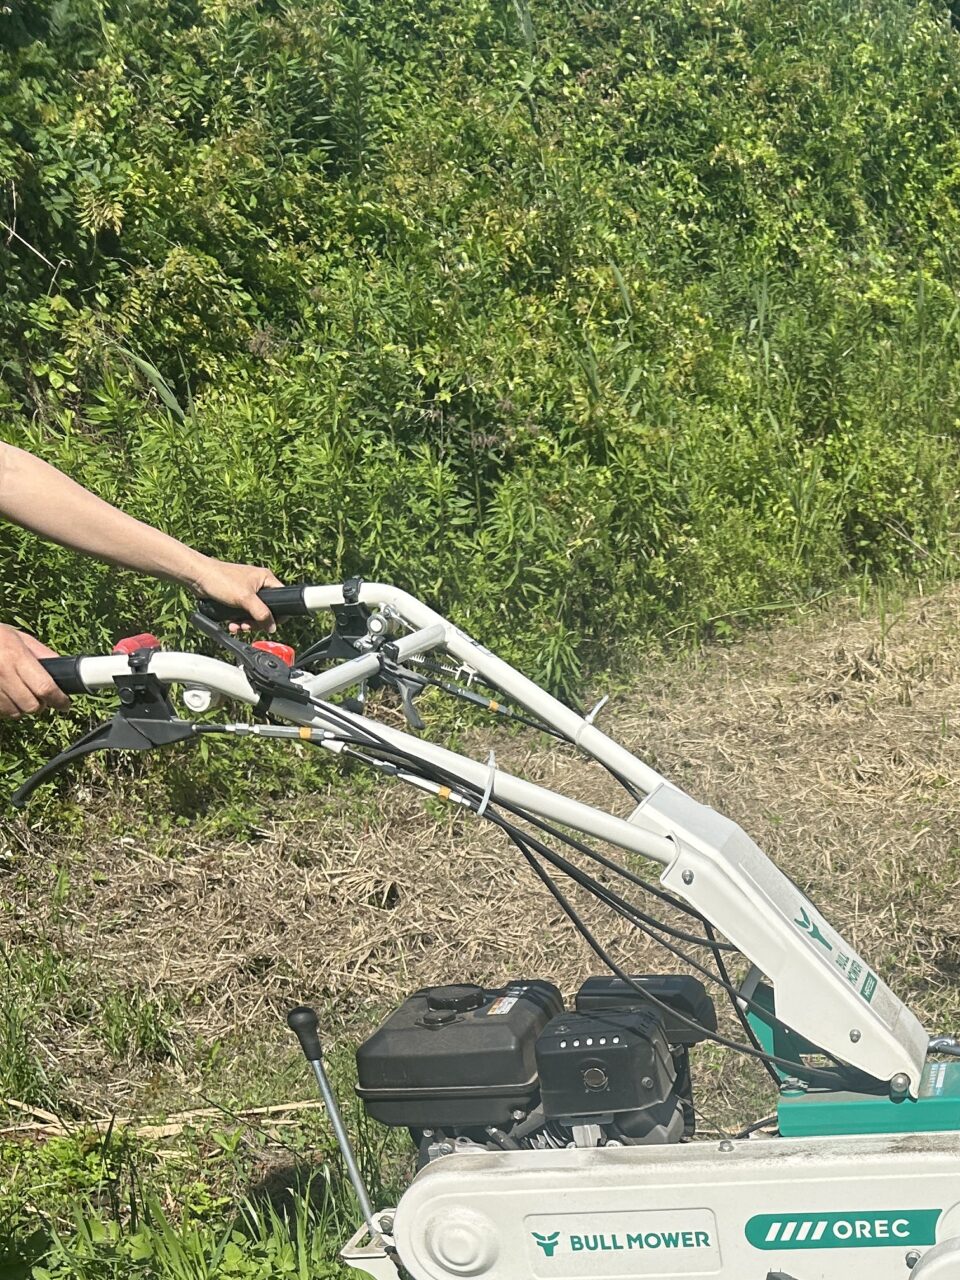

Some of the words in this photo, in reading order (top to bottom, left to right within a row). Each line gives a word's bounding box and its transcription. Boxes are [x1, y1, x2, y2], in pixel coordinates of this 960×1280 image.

[832, 1218, 911, 1240] OREC
[569, 1233, 624, 1251] BULL
[626, 1231, 711, 1249] MOWER
